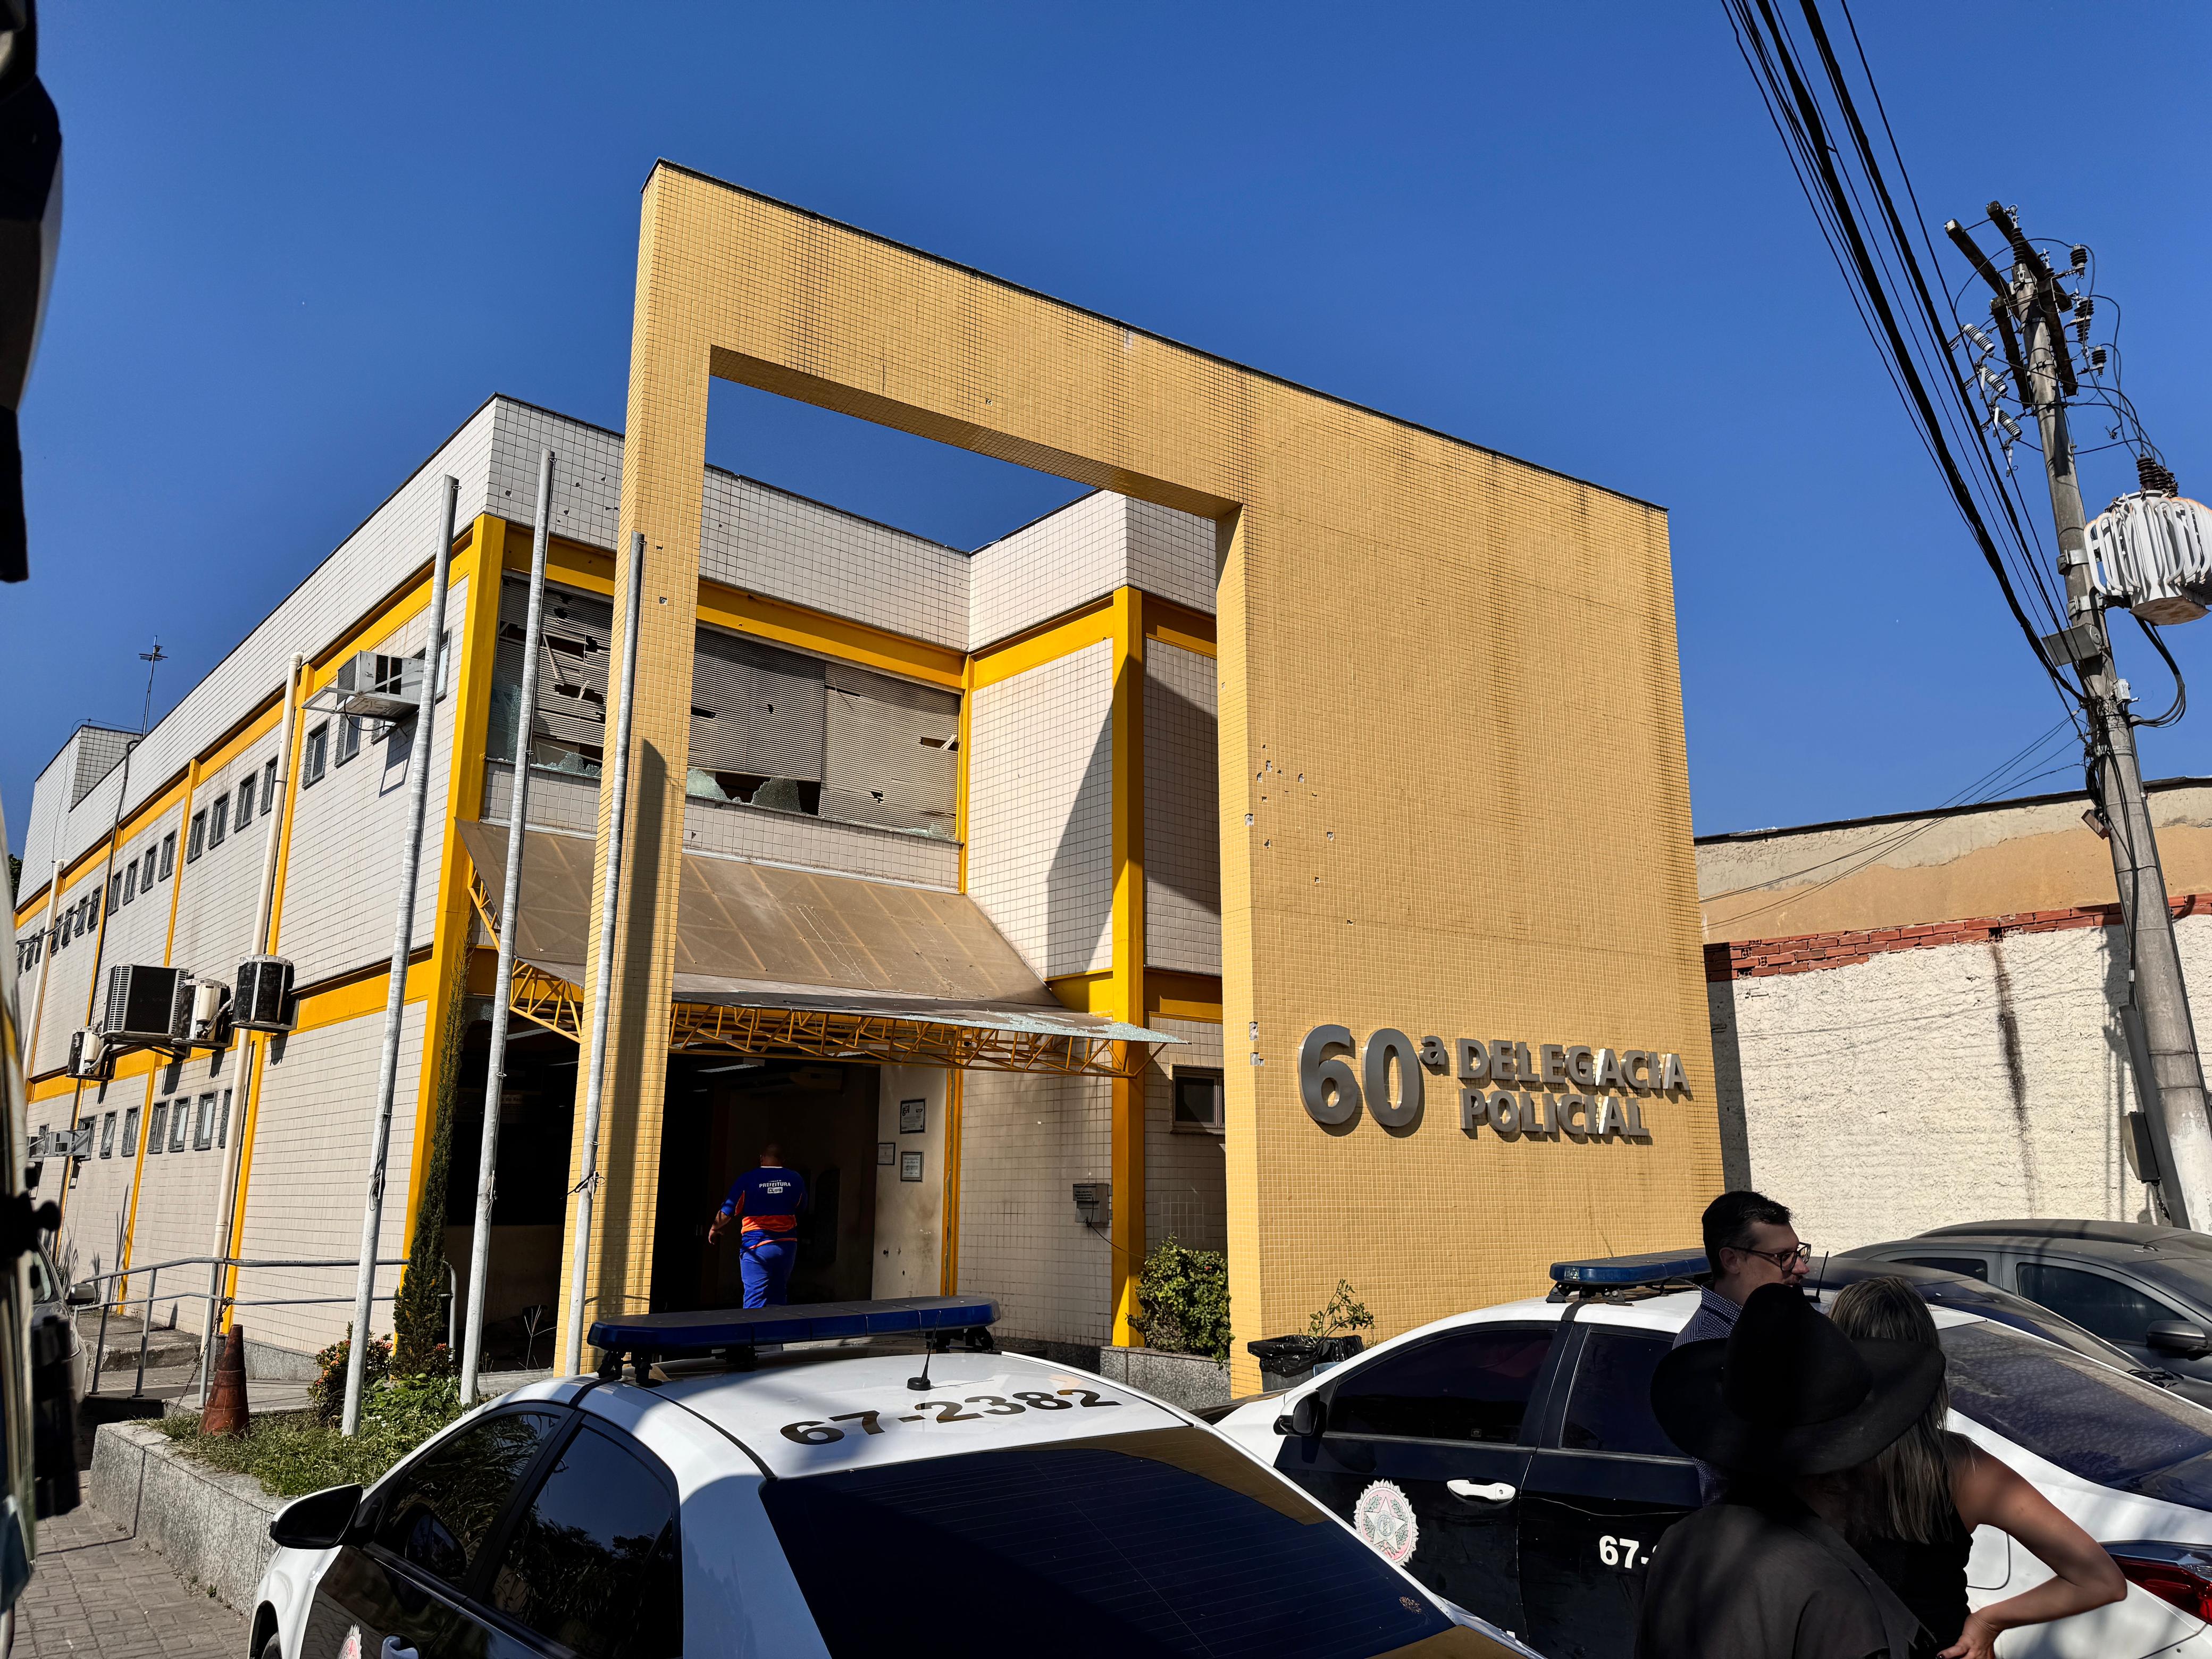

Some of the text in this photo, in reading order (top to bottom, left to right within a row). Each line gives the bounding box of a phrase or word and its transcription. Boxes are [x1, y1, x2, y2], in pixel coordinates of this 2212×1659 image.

[1456, 1038, 1690, 1091] DELEGACIA
[1458, 1088, 1650, 1137] POLICIAL
[780, 1389, 1122, 1445] 67-2382
